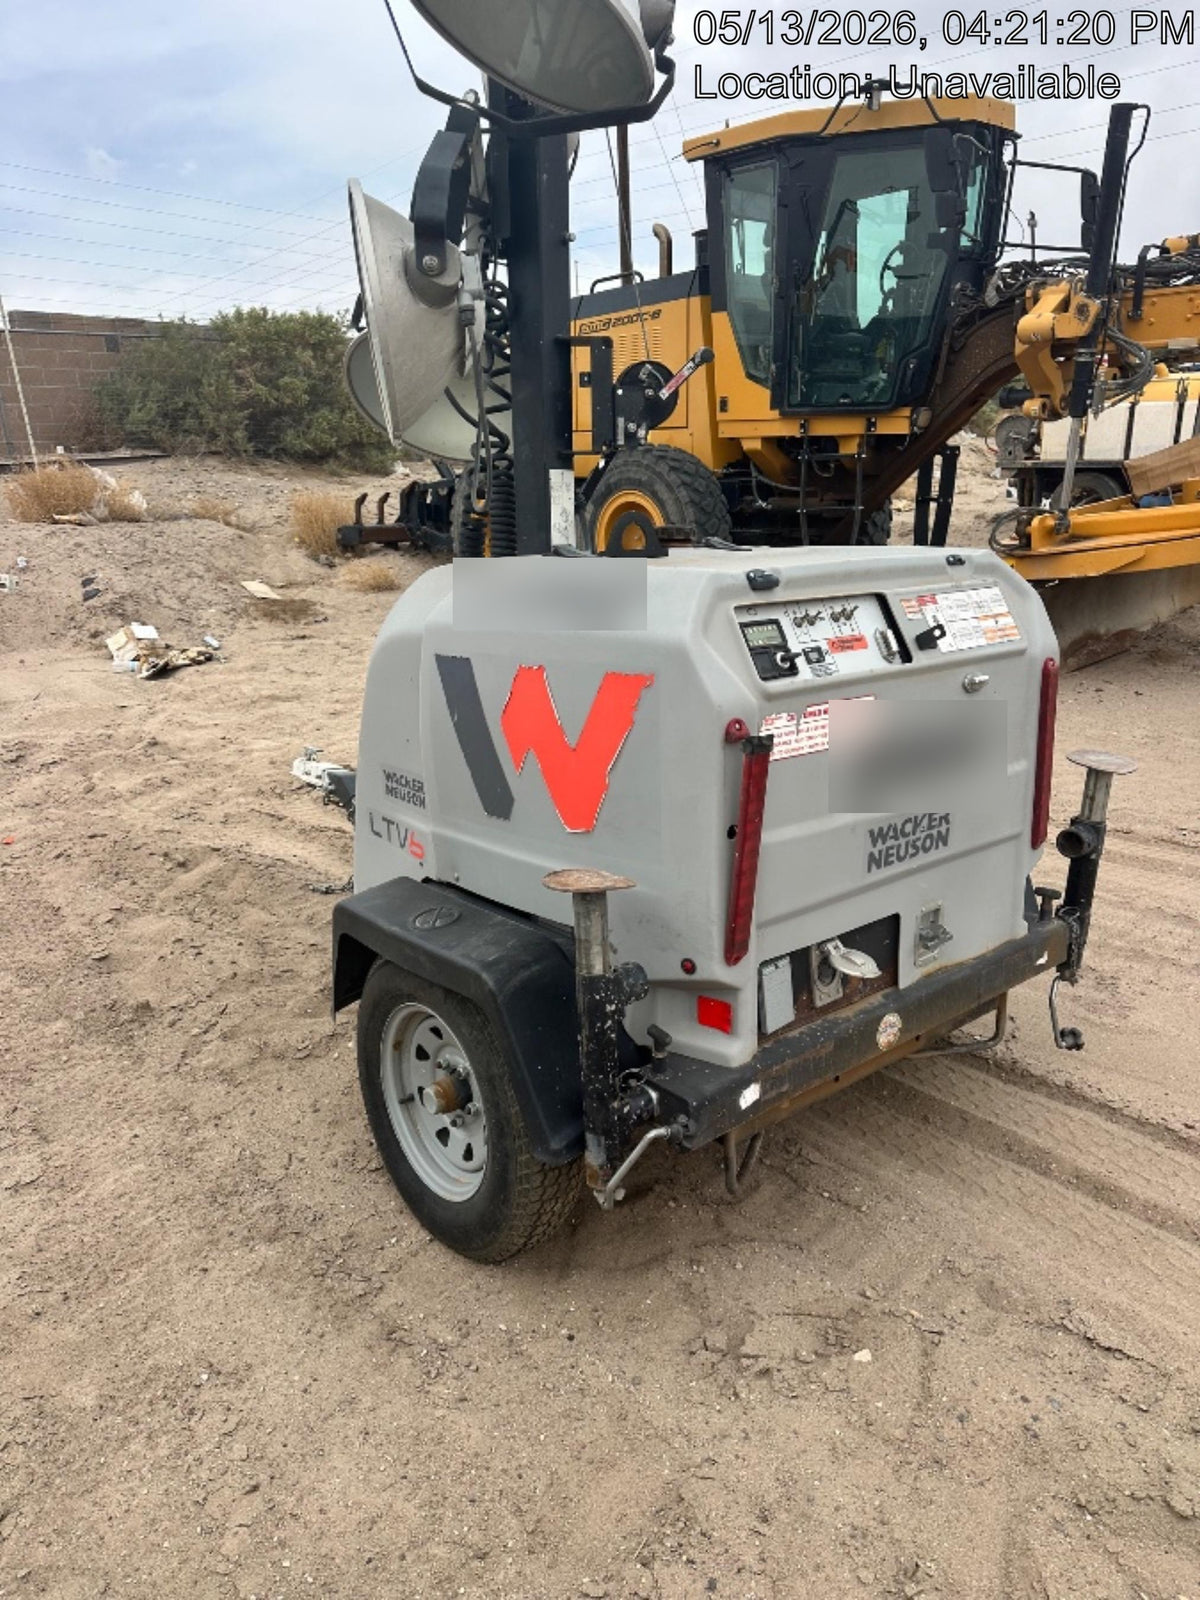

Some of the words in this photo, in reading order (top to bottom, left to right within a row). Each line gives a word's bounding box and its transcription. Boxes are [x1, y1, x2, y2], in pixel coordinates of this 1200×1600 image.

[383, 769, 424, 795] WACKER
[385, 783, 426, 809] NEUSON
[369, 812, 425, 861] LTV6
[867, 827, 950, 873] NEUSON
